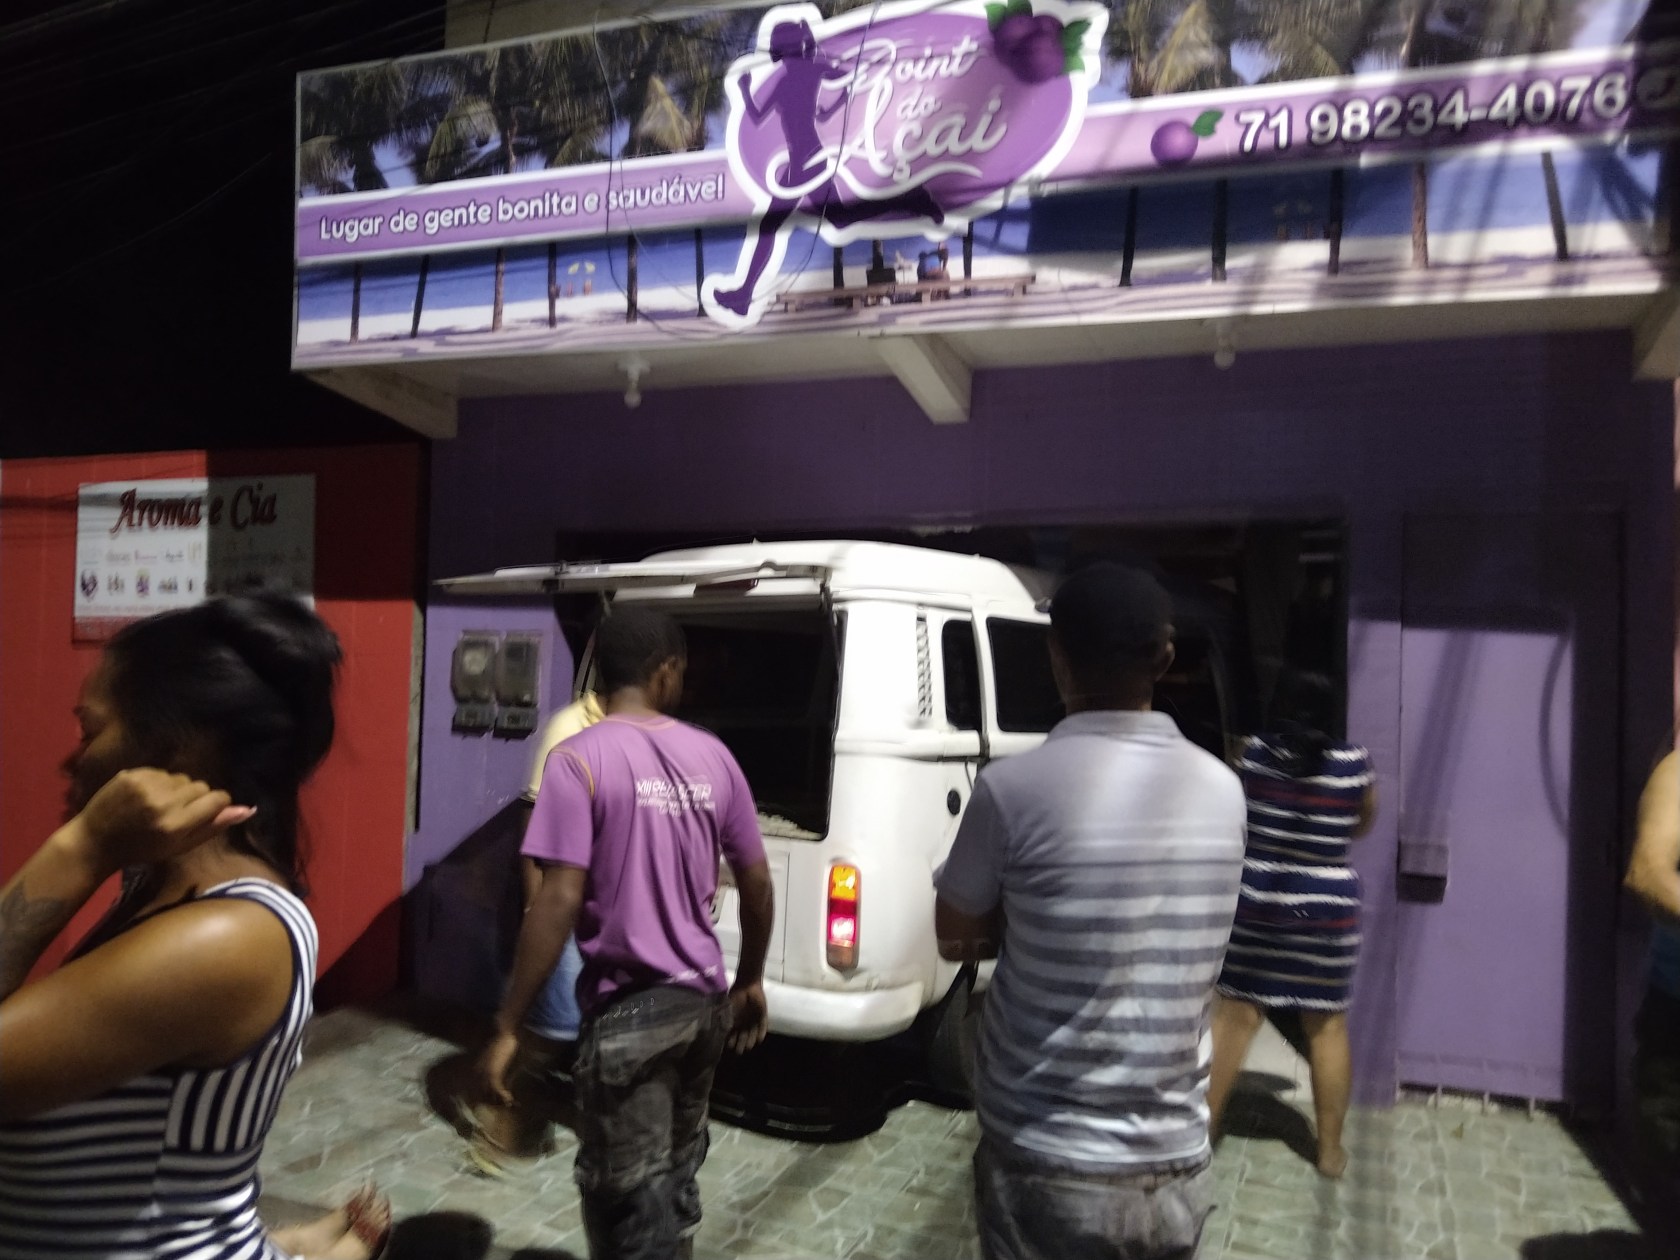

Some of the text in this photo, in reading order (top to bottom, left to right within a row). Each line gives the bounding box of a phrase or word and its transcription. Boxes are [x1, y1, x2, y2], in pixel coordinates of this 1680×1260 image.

[821, 35, 979, 94] Point
[897, 88, 942, 121] do
[1237, 72, 1628, 153] 71 98234-4076
[320, 172, 726, 243] Lugar de gente bonita e saudável
[109, 482, 278, 534] Aroma e Cia
